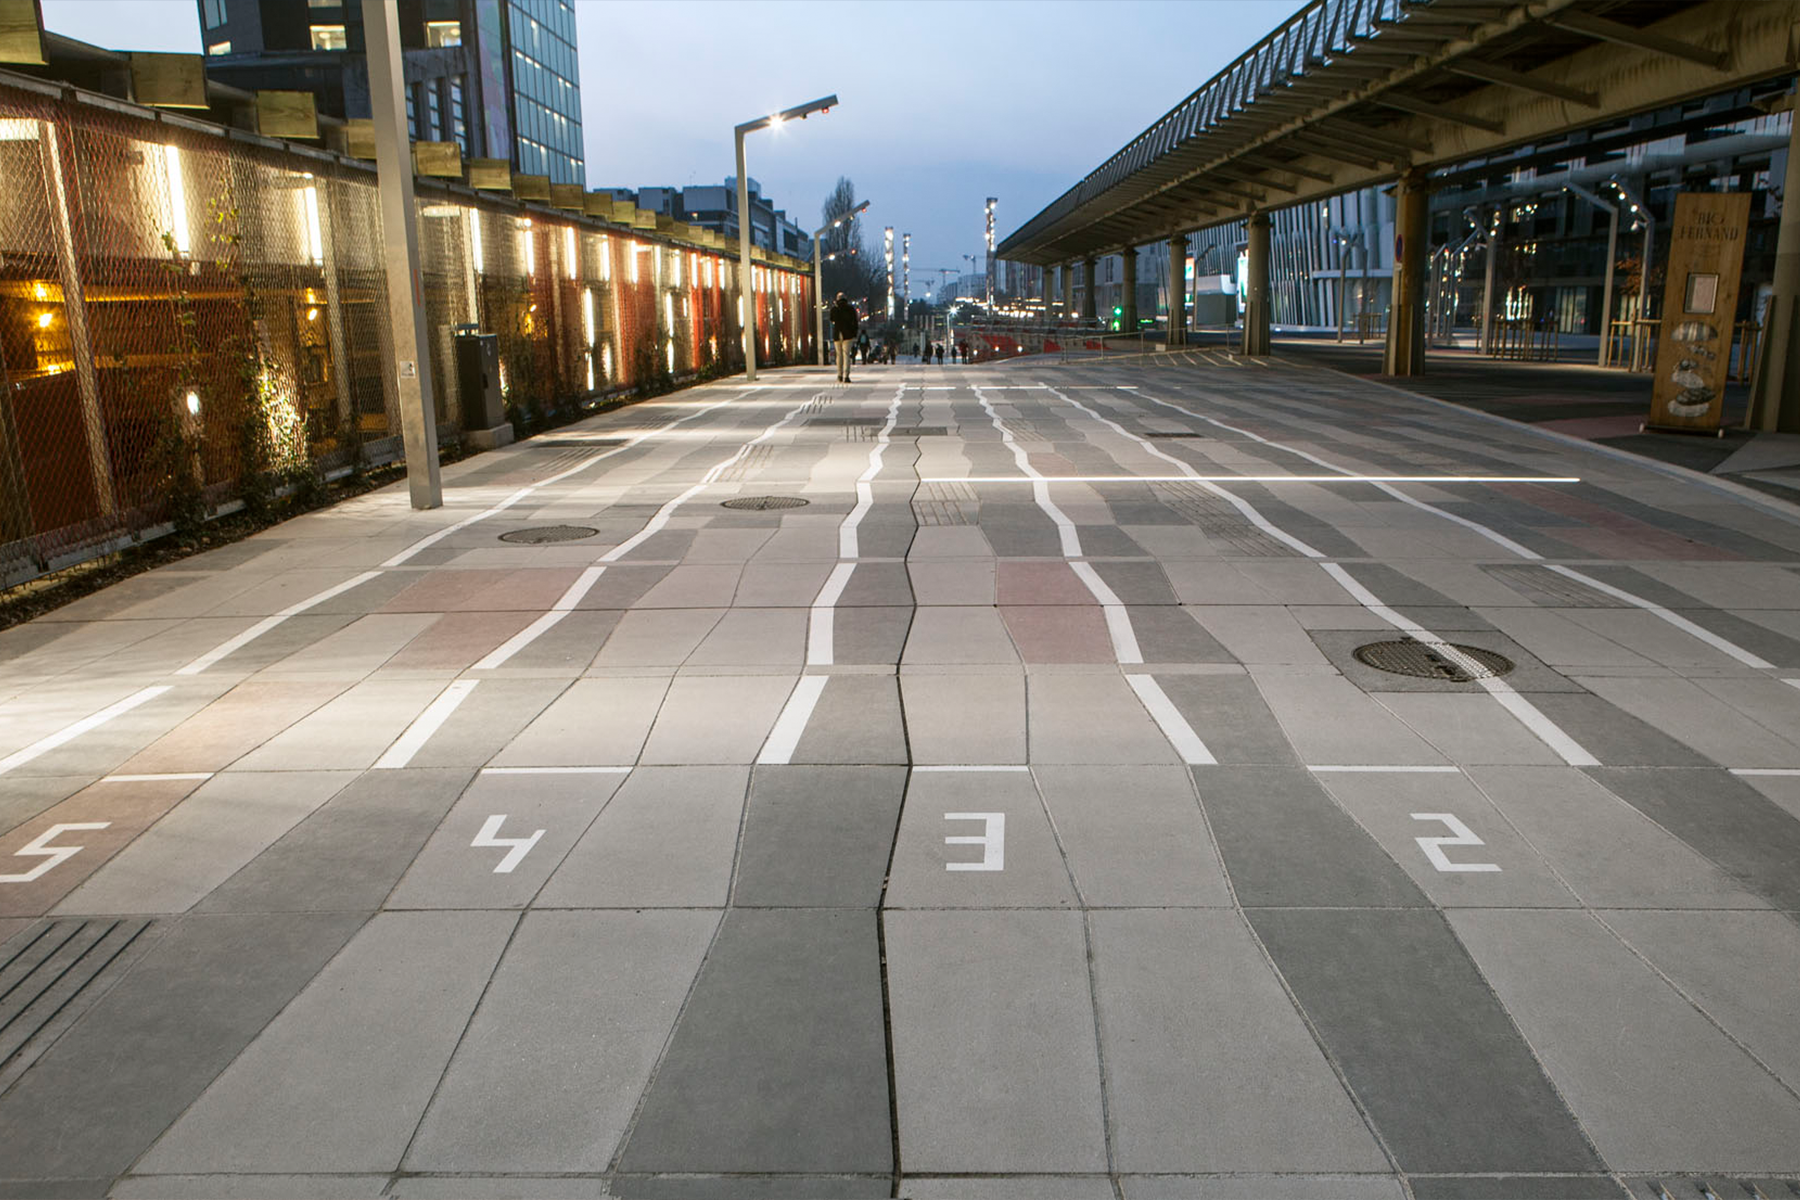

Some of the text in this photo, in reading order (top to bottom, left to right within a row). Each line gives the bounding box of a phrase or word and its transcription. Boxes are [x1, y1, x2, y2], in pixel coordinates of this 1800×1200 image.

[1678, 226, 1739, 241] FERNAND
[0, 821, 112, 883] 5
[470, 813, 548, 874] 4
[944, 812, 1006, 872] 3
[1410, 812, 1503, 872] 2
